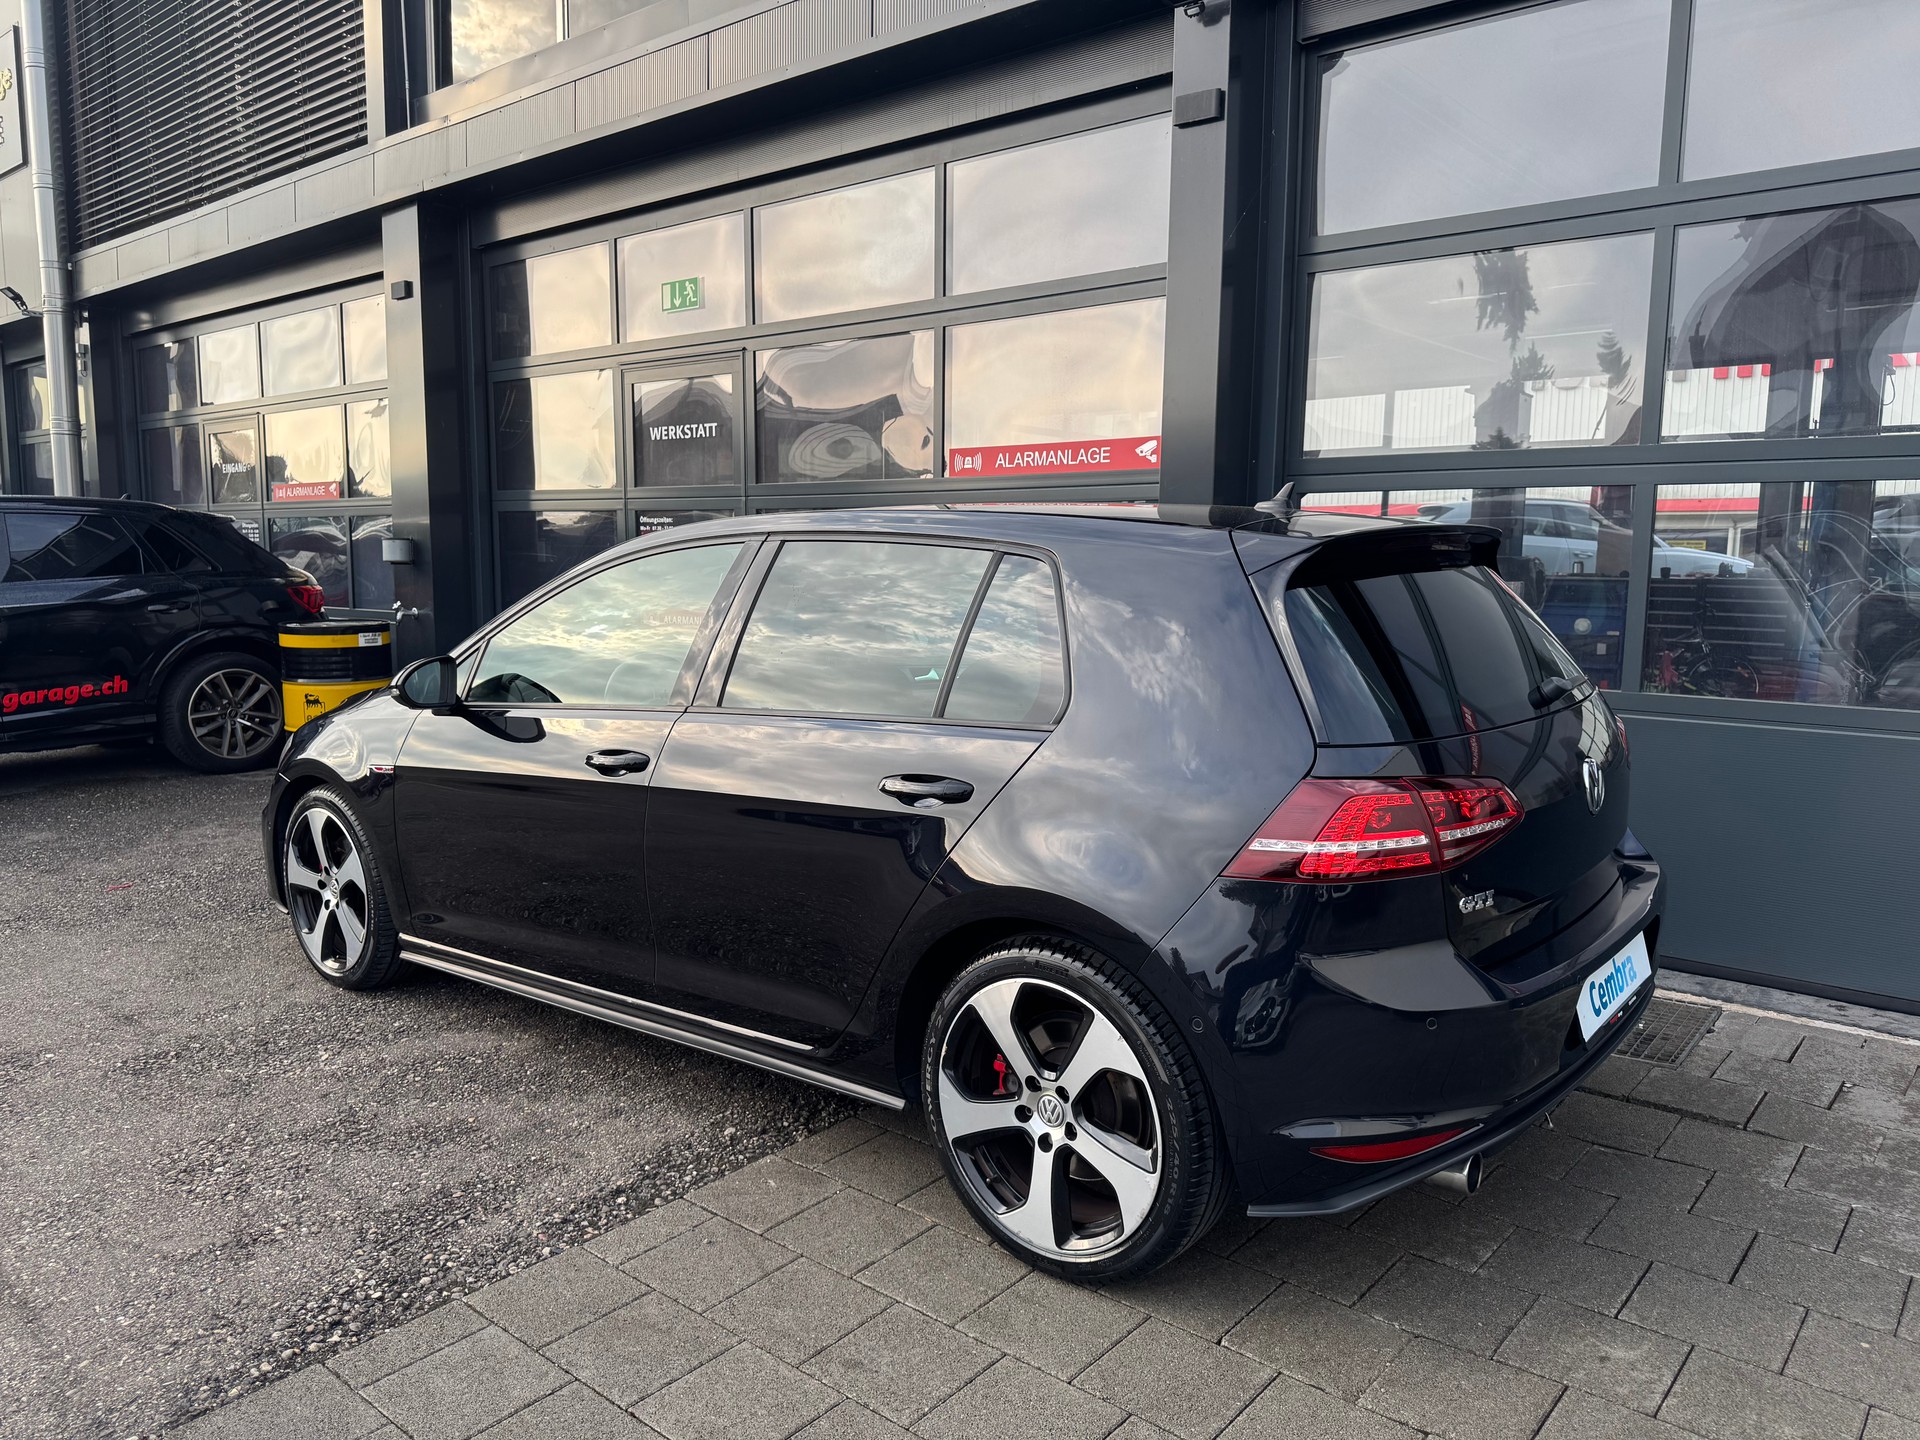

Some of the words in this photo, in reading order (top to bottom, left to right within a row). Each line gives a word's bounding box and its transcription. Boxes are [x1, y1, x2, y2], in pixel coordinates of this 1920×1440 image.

[649, 422, 718, 441] WERKSTATT
[995, 447, 1111, 468] ALARMANLAGE
[222, 462, 247, 474] EINGANG
[286, 485, 326, 497] ALARMANLAGE
[1459, 889, 1495, 914] GTI
[1589, 955, 1637, 1018] Cembra
